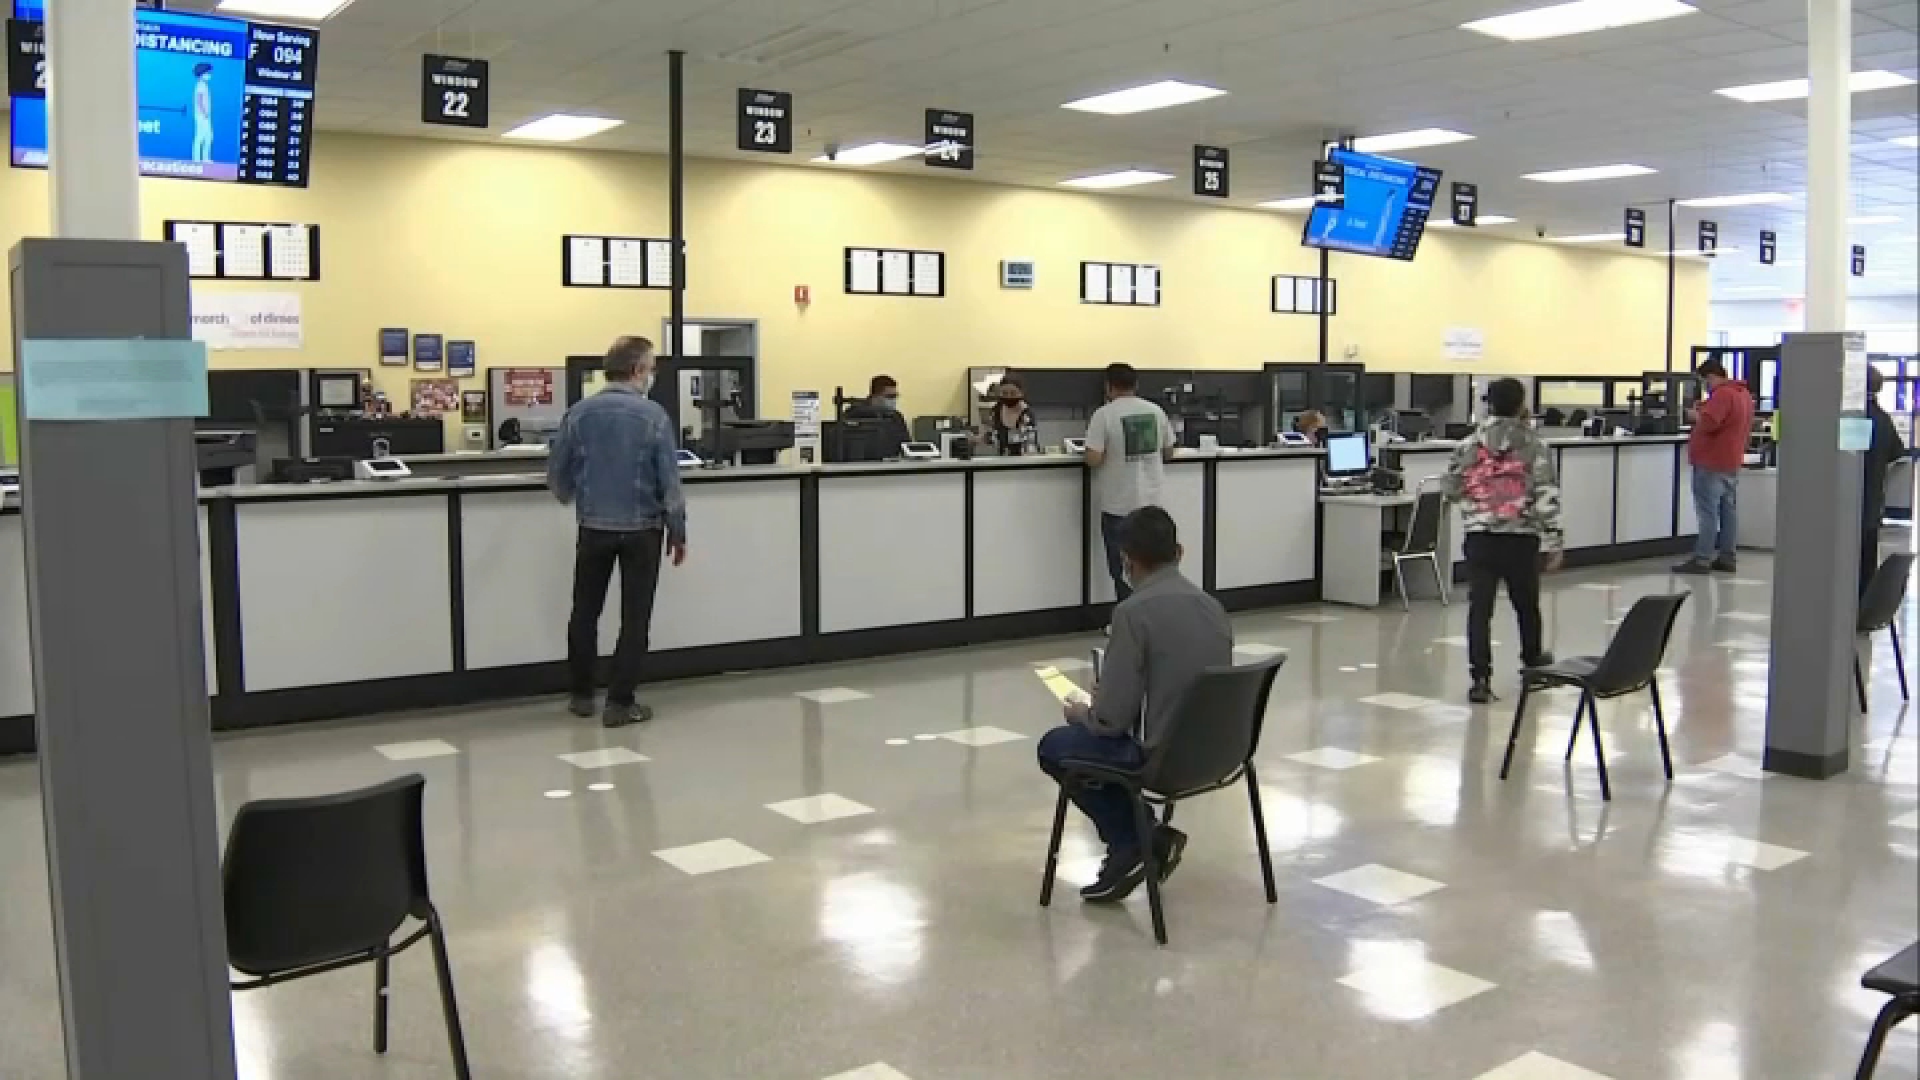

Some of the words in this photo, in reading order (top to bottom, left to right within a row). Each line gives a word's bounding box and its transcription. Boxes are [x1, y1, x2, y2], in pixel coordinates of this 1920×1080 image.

[278, 31, 310, 48] Serving
[248, 43, 258, 60] F
[274, 46, 301, 64] 094
[431, 73, 480, 89] WINDOW
[442, 90, 470, 118] 22
[745, 105, 785, 119] WINDOW
[754, 120, 777, 145] 23
[250, 312, 262, 325] of
[263, 312, 299, 325] dimes
